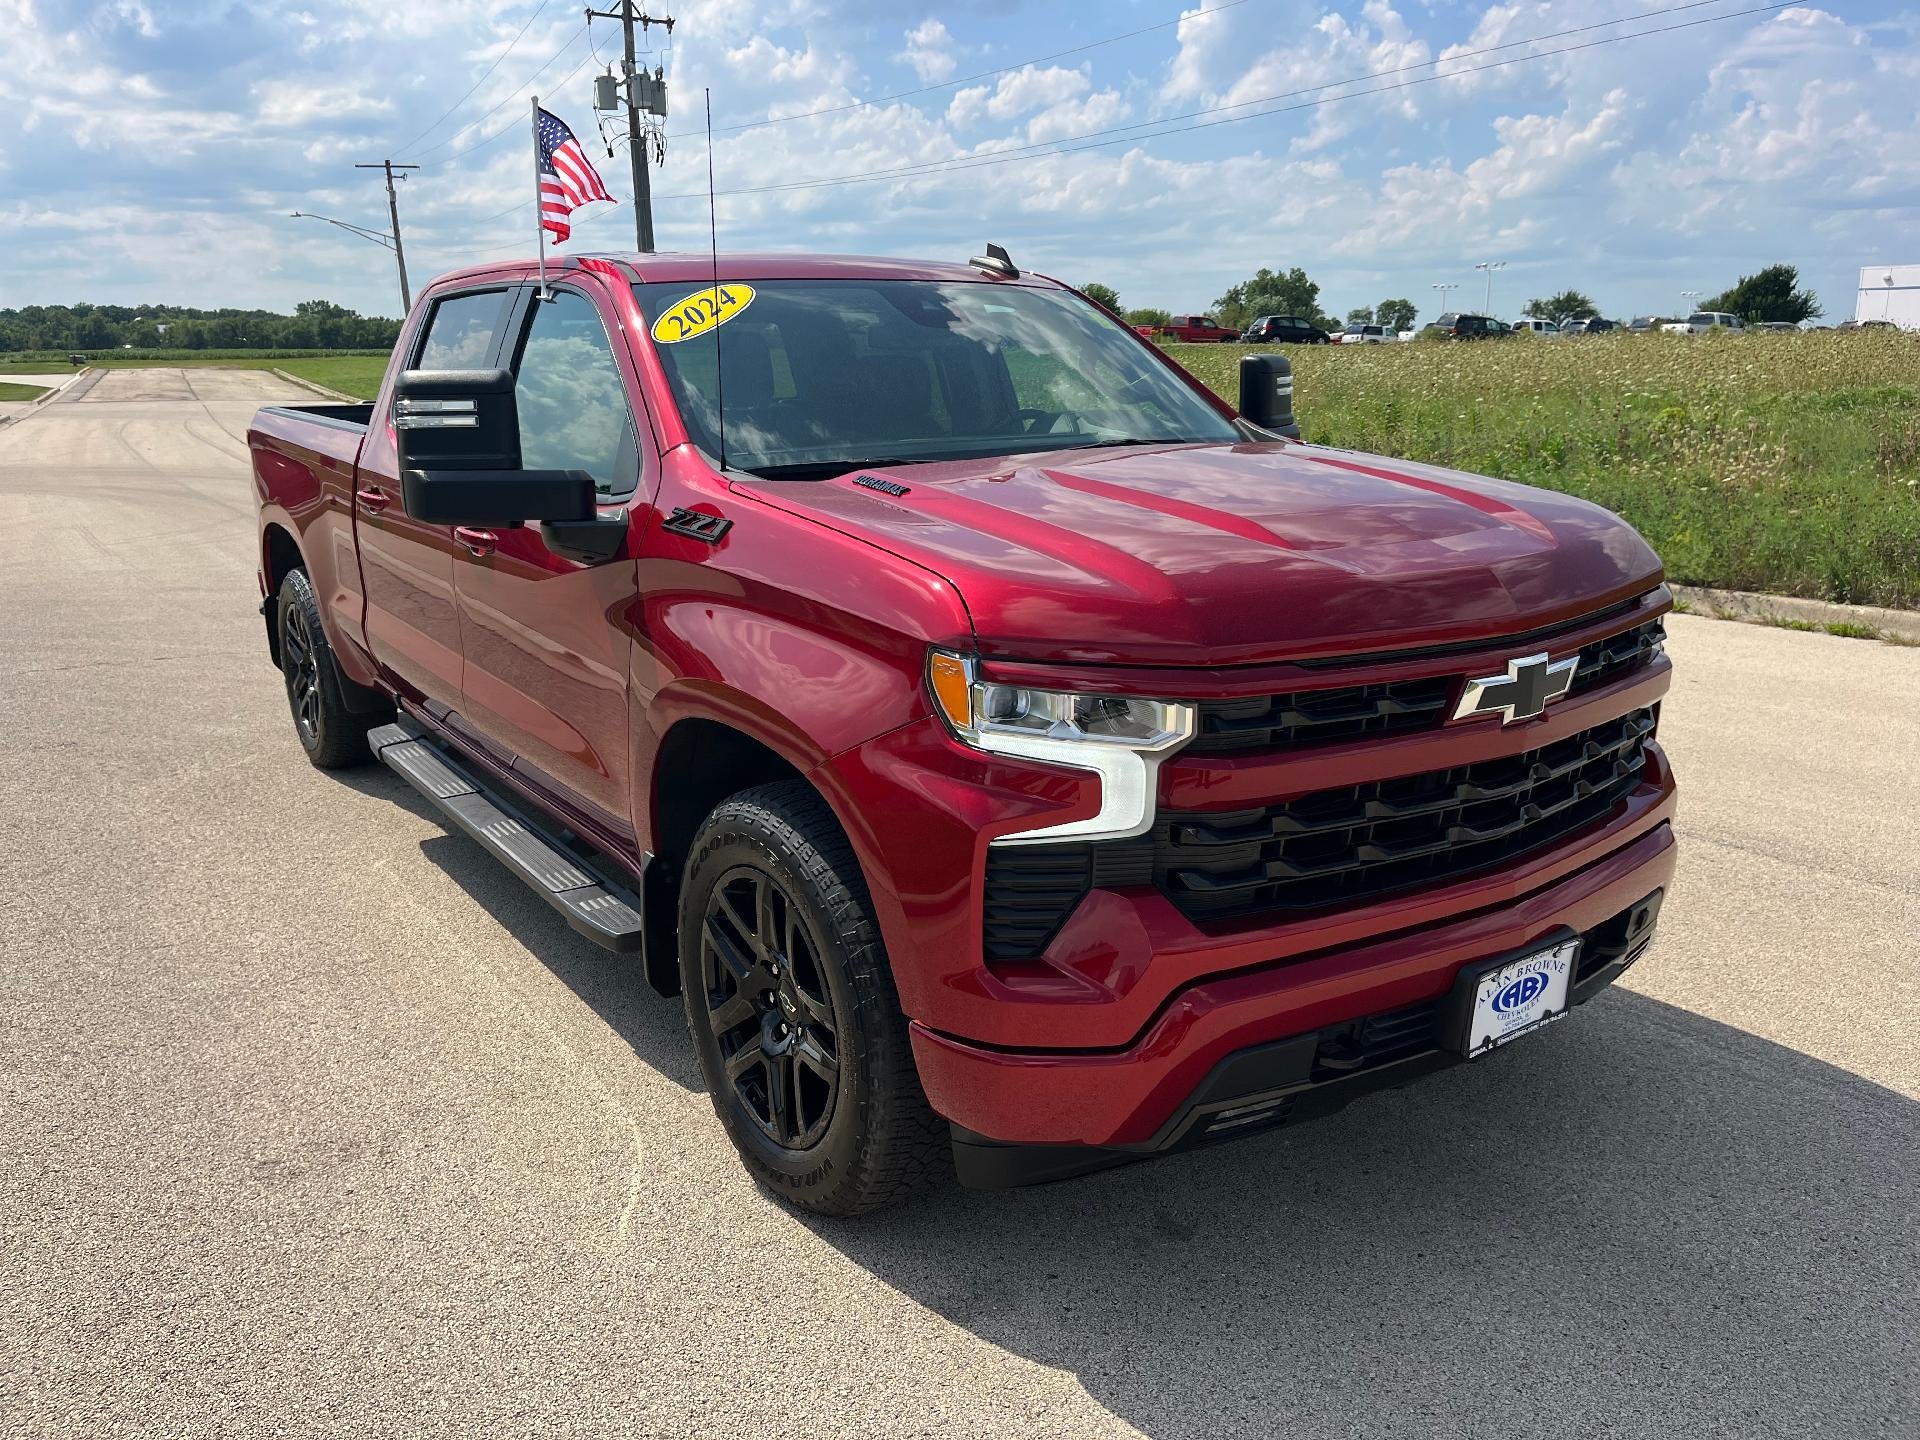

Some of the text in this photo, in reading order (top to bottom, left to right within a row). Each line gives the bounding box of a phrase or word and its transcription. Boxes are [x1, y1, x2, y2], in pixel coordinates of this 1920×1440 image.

[667, 288, 737, 338] 2024
[661, 507, 734, 546] Z71
[1479, 959, 1566, 1009] ALAN BROWNE
[1496, 997, 1540, 1021] CHEVROLET
